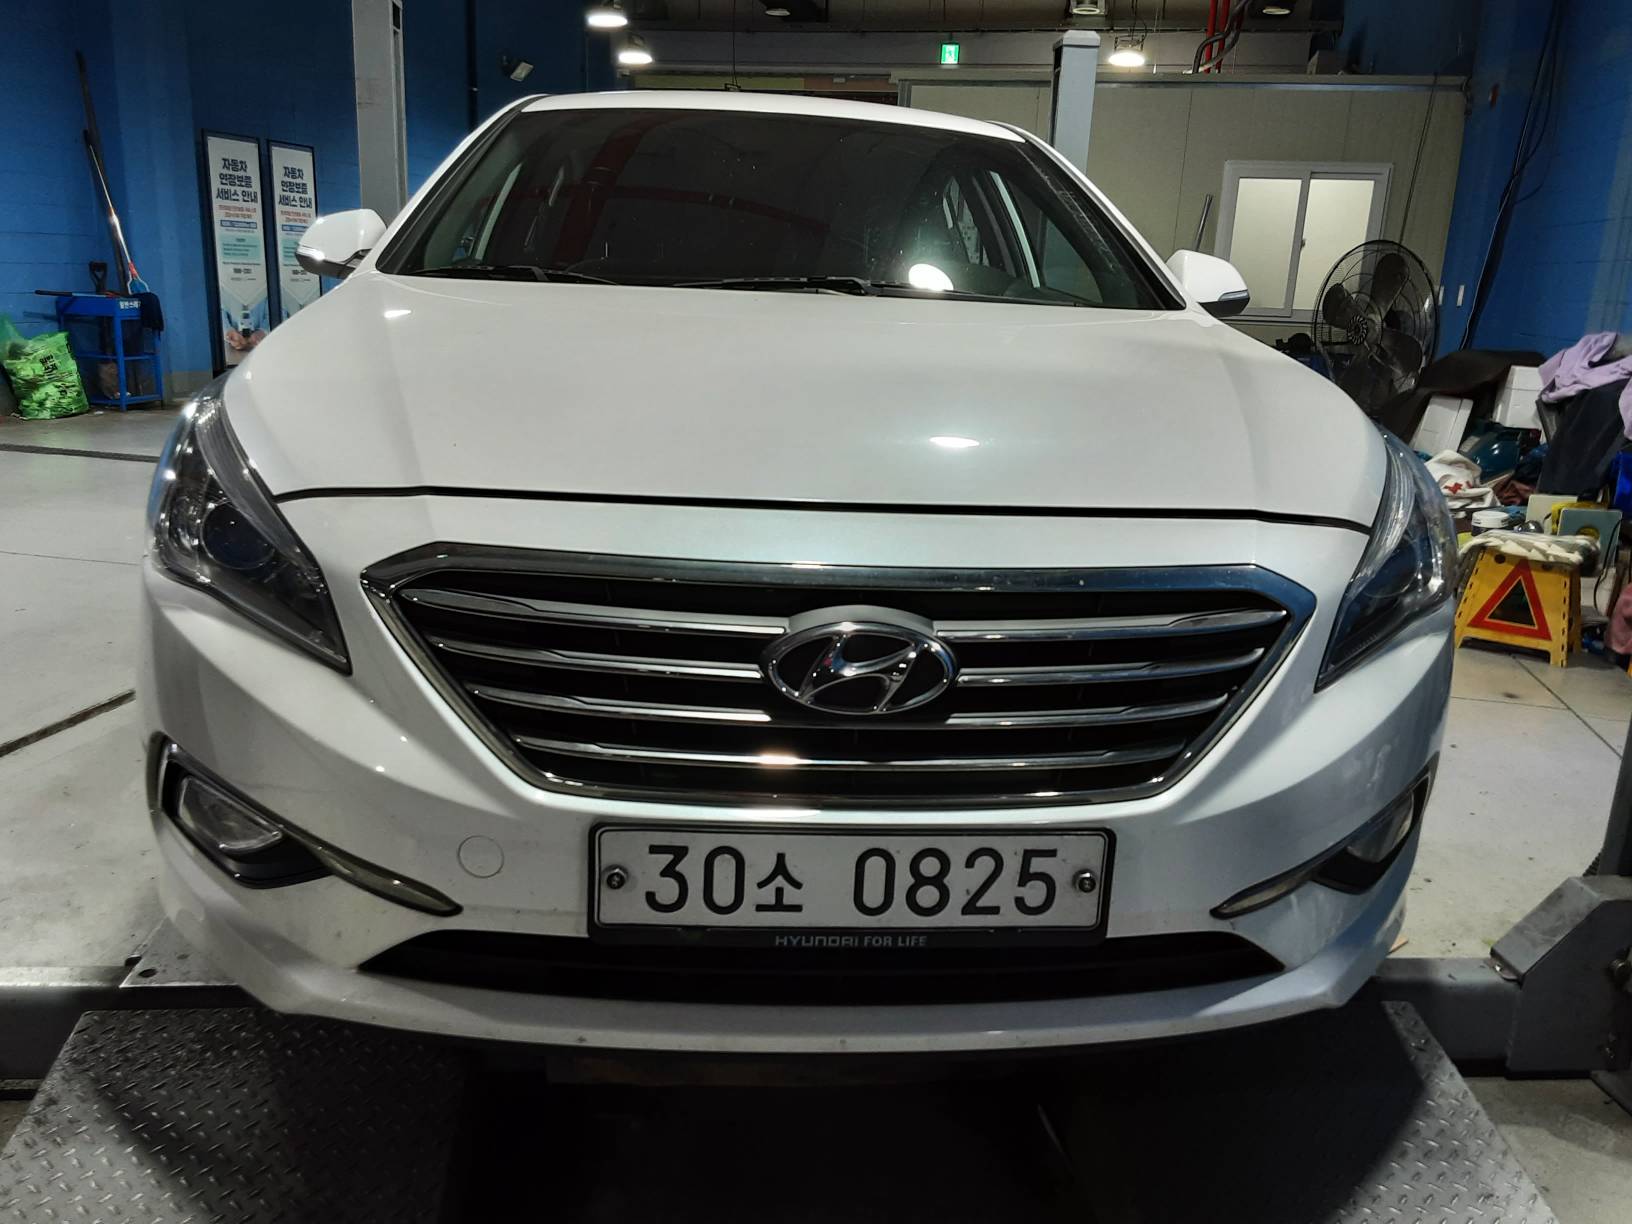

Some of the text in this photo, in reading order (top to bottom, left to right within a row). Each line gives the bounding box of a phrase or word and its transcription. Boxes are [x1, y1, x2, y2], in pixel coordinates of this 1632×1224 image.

[222, 158, 248, 172] 자동차
[283, 166, 304, 180] 자동차
[219, 173, 252, 188] 연장보증
[281, 180, 308, 194] 연장보증
[216, 187, 258, 204] 서비스 안내
[279, 194, 313, 208] 서비스 안내
[645, 844, 1057, 917] 30소 0825
[775, 935, 927, 947] HYUNDAI FOR LIFE
